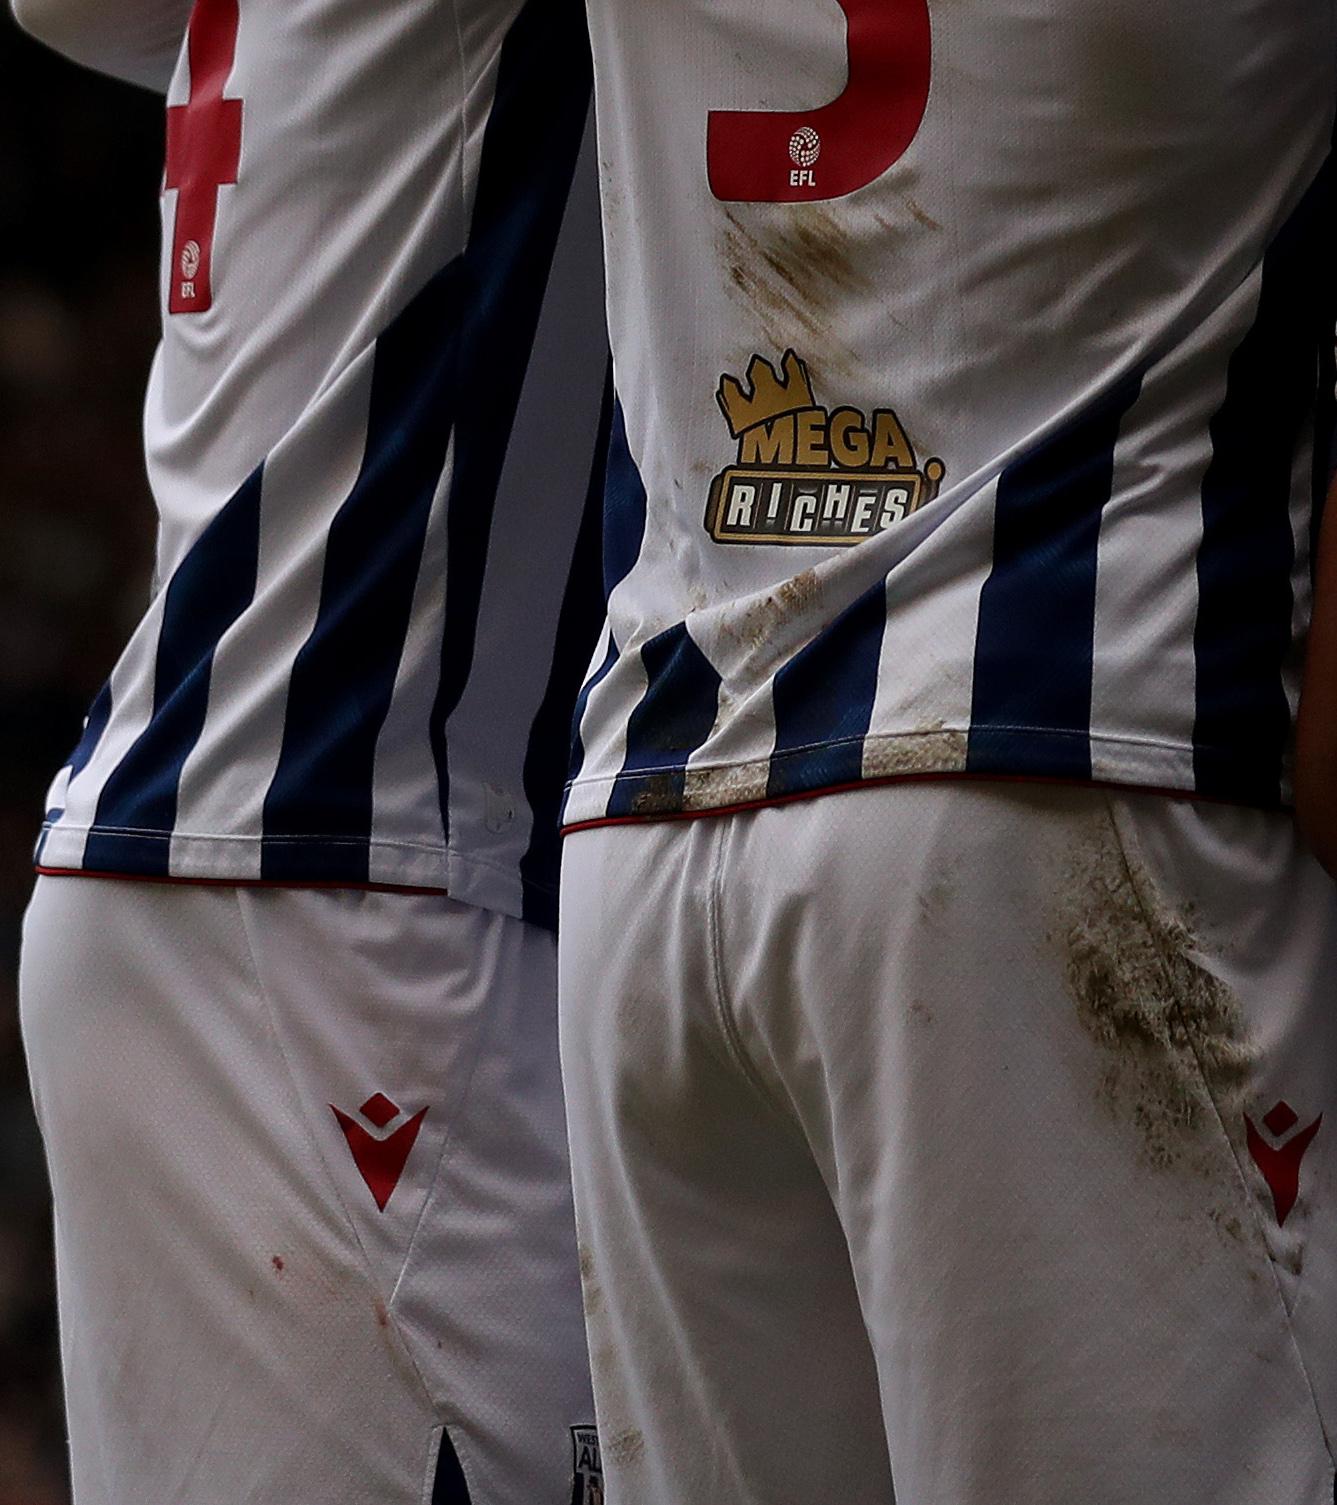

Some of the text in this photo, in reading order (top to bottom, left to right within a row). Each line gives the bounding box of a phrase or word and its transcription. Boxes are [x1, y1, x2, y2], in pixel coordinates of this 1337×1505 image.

[789, 169, 816, 187] EFL
[738, 407, 917, 470] MEGA
[725, 481, 910, 533] RICHES
